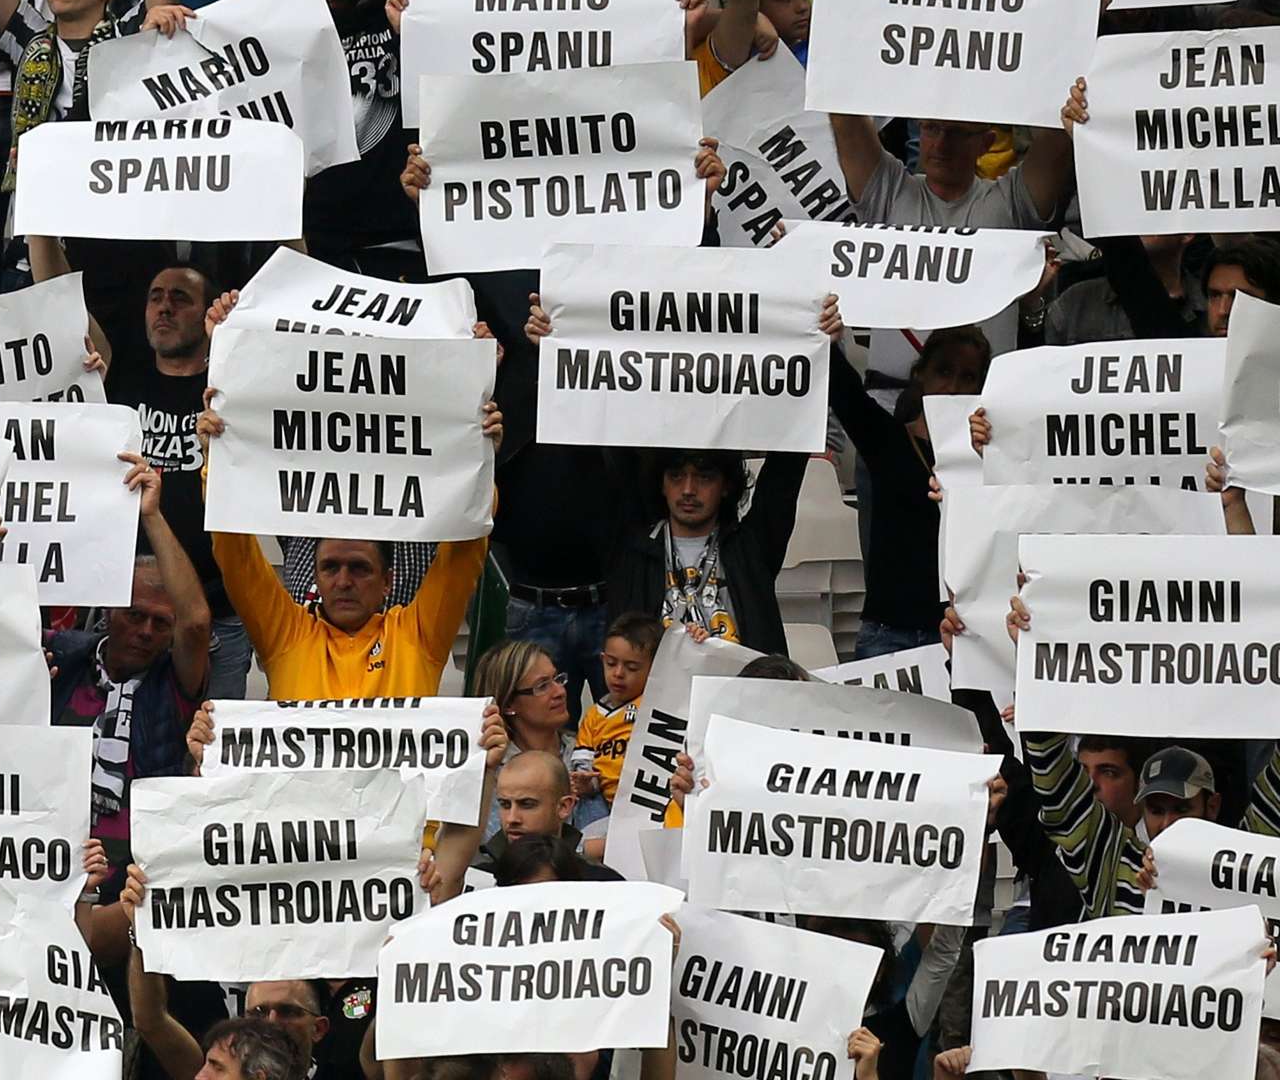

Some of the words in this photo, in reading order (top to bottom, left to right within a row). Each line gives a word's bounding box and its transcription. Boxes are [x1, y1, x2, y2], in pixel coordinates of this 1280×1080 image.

[1159, 43, 1265, 90] JEAN
[480, 111, 637, 161] BENITO
[89, 154, 231, 194] SPANU
[443, 168, 682, 222] PISTOLATO
[831, 239, 973, 284] SPANU
[311, 284, 423, 327] JEAN
[556, 348, 811, 398] MASTROIACO
[1071, 353, 1183, 395] JEAN
[272, 409, 433, 457] MICHEL
[1046, 412, 1208, 457] MICHEL
[278, 470, 425, 518] WALLA
[1089, 578, 1241, 623] GIANNI
[220, 726, 469, 769] MASTROIACO
[766, 763, 921, 803] GIANNI
[203, 819, 358, 867] GIANNI
[708, 809, 965, 870] MASTROIACO
[150, 877, 414, 930] MASTROIACO
[1043, 932, 1199, 966] GIANNI
[394, 956, 652, 1003] MASTROIACO
[675, 954, 808, 1029] GIANNI
[981, 979, 1244, 1032] MASTROIACO
